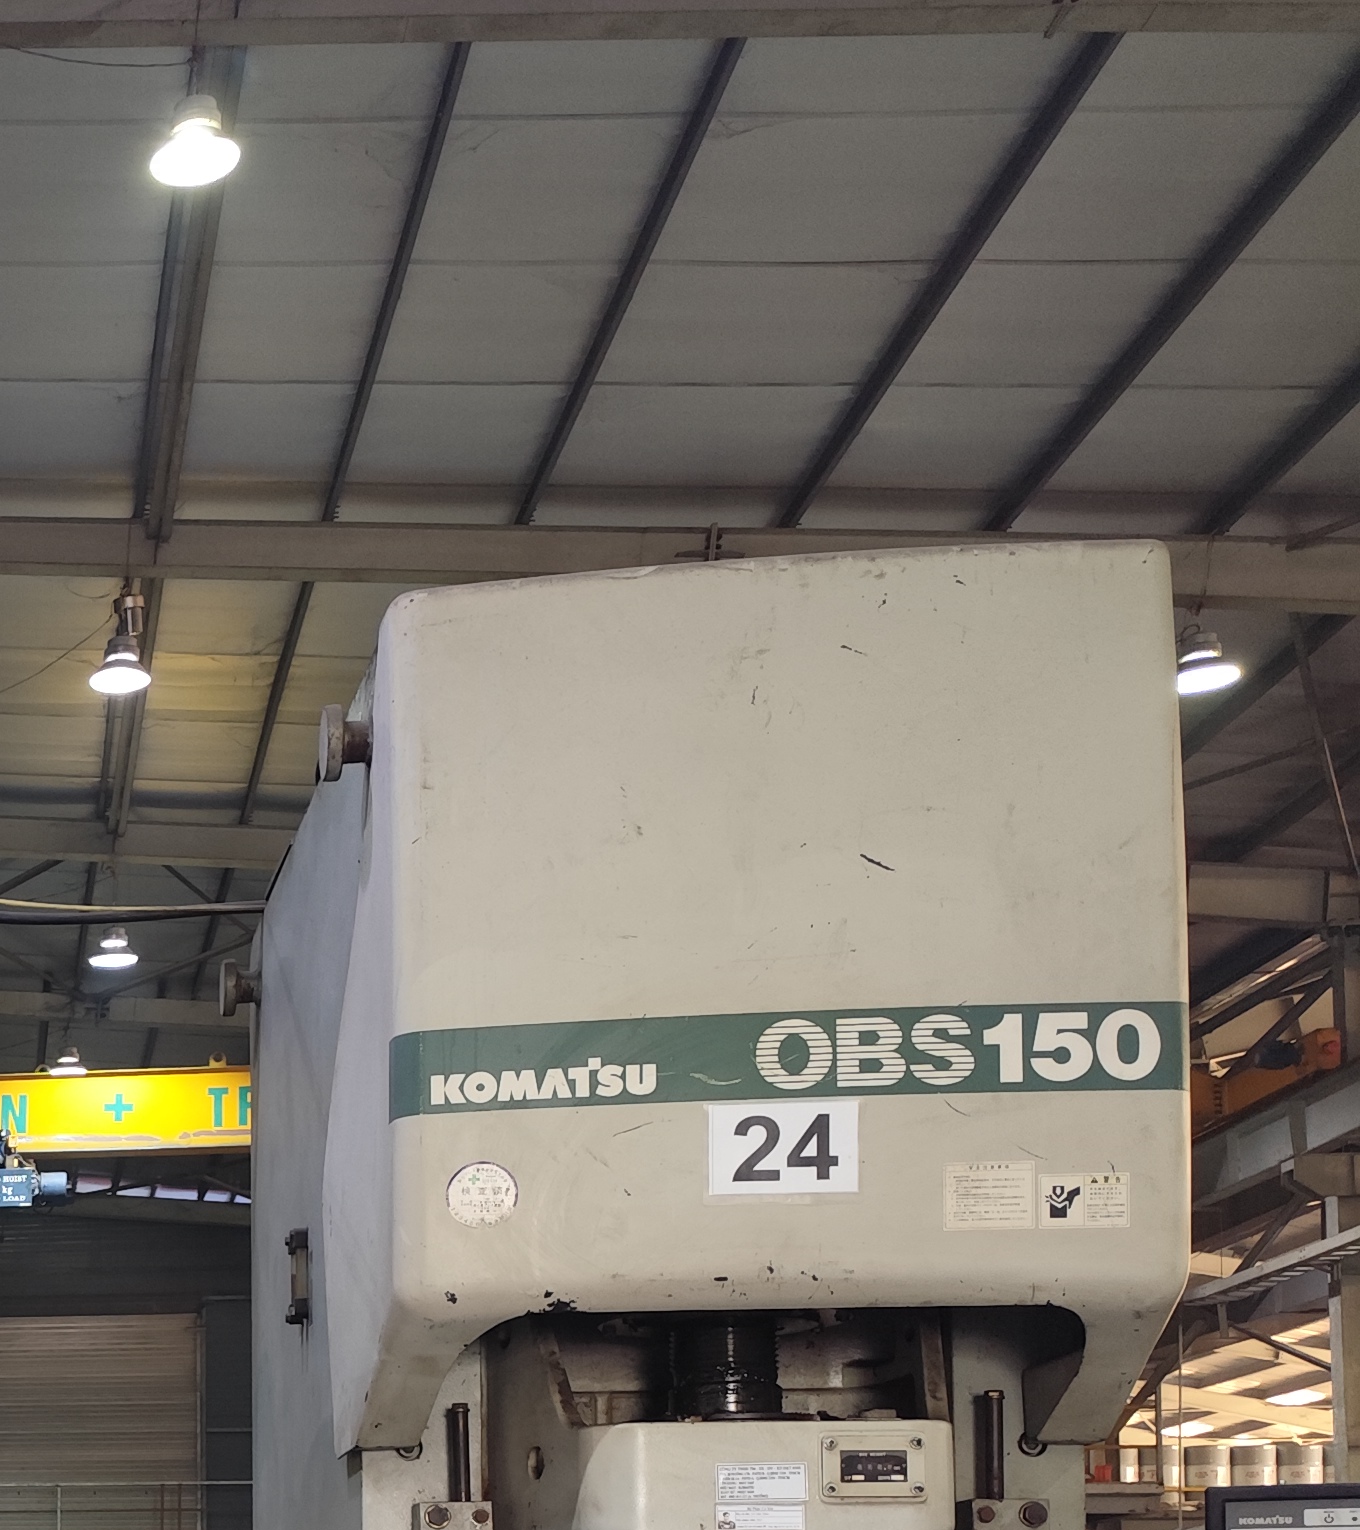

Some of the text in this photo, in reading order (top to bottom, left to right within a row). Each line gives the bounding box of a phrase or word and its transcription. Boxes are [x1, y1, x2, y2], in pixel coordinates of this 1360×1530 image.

[755, 1008, 1161, 1090] OBS150
[430, 1056, 657, 1106] KOMATSU
[732, 1113, 839, 1182] 24
[1, 1185, 14, 1196] kg
[1238, 1514, 1294, 1525] KOMATSU
